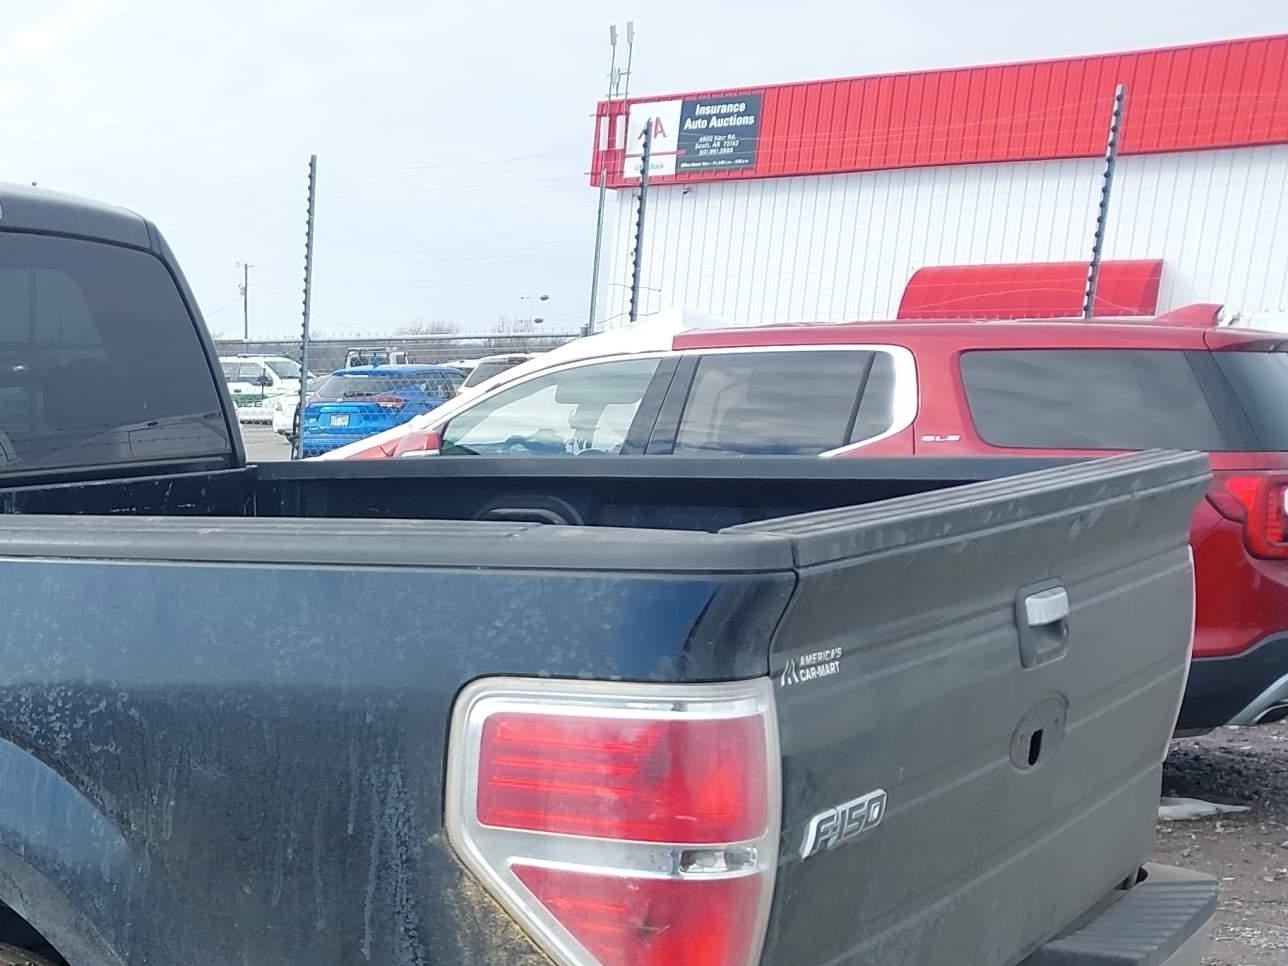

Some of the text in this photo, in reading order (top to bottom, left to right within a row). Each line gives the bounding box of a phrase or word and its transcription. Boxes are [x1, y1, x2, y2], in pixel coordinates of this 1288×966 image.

[695, 102, 746, 115] Insurance
[684, 114, 755, 130] Auto Auctions
[800, 647, 843, 666] AMERICA'S
[800, 661, 840, 682] CAR-MART
